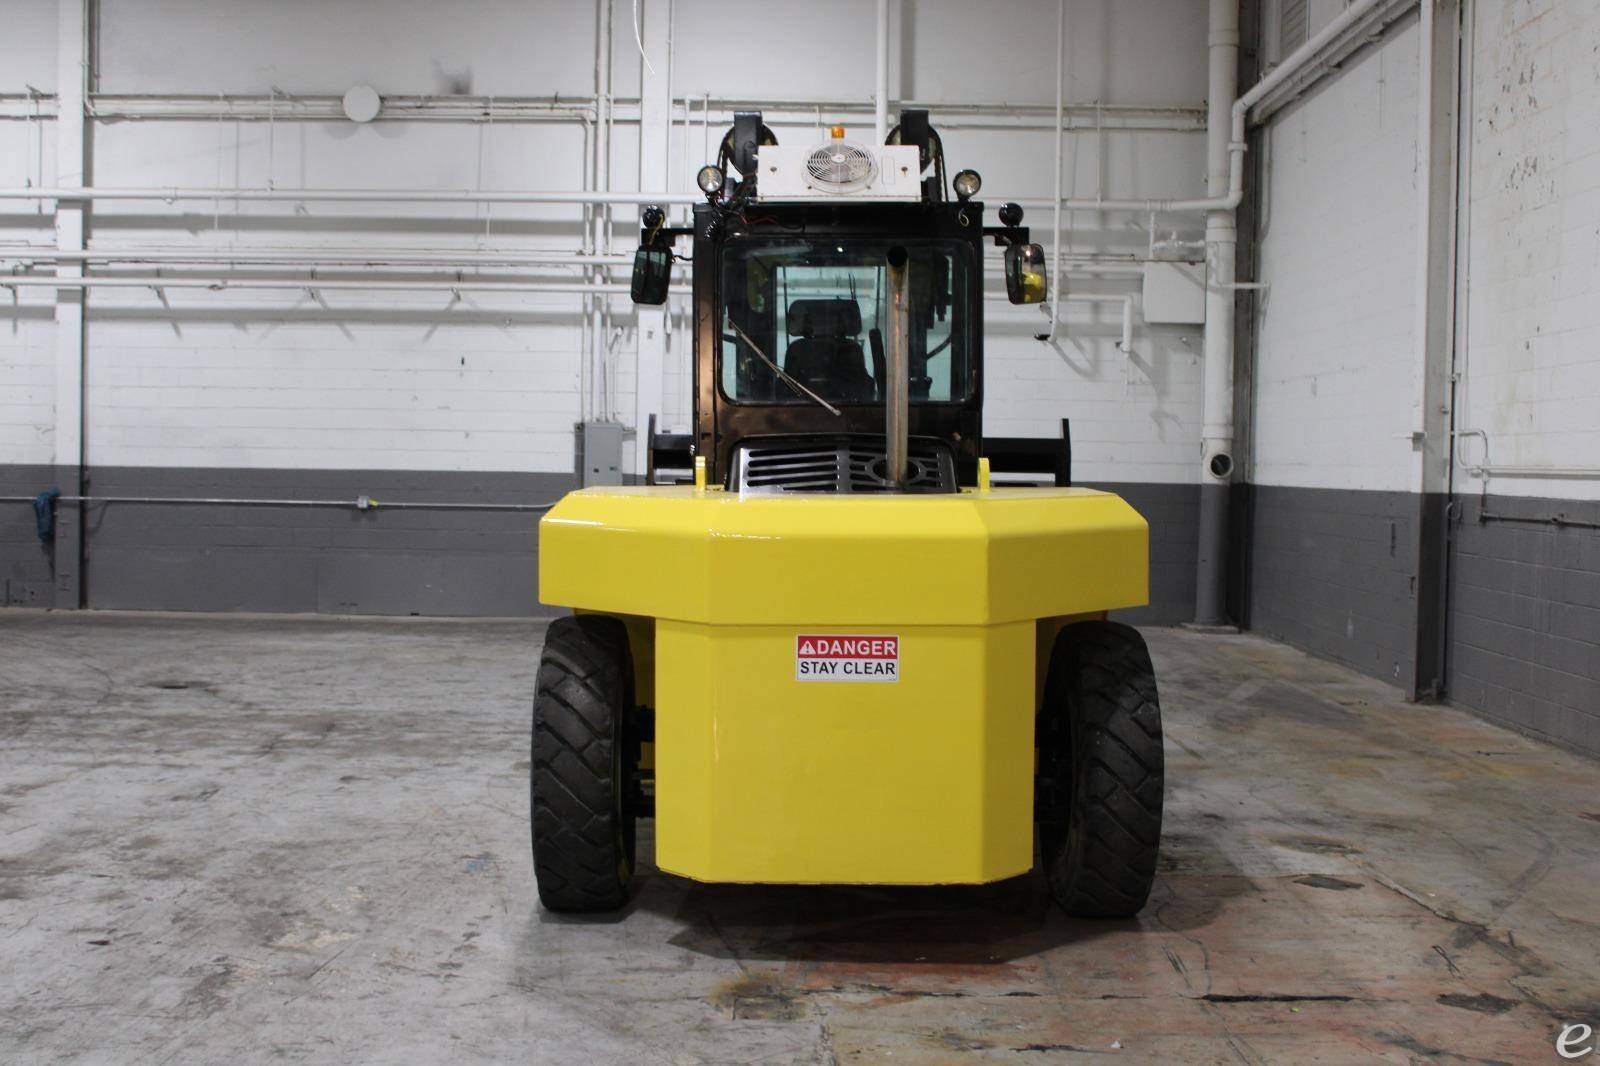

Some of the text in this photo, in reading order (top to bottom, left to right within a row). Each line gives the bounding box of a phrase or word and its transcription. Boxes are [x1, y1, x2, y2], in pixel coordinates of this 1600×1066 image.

[817, 640, 896, 655] DANGER
[800, 661, 895, 675] STAY CLEAR
